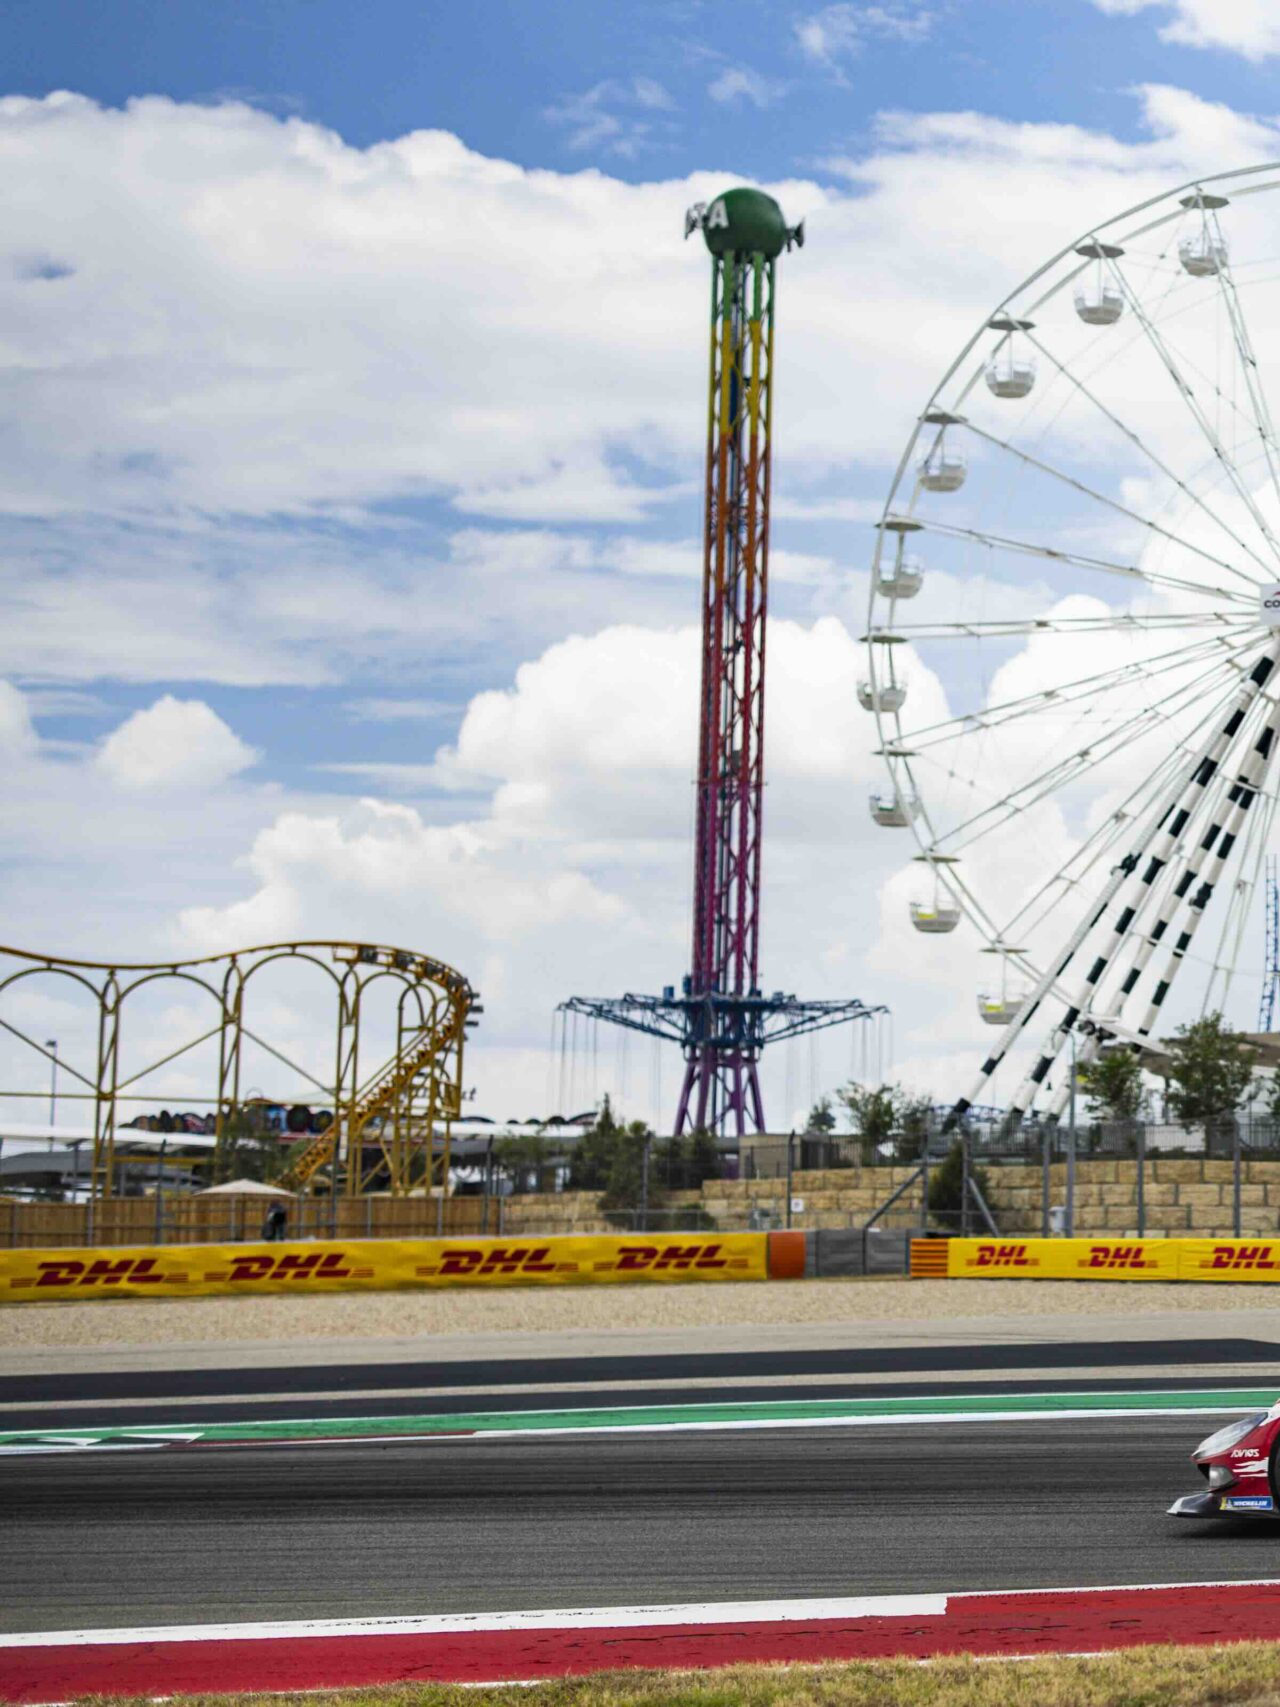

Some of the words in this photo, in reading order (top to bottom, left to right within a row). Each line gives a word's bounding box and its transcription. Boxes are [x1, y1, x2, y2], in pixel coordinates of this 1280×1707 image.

[228, 1253, 350, 1281] DHL
[438, 1248, 556, 1276] DHL
[616, 1245, 729, 1270] DHL
[976, 1246, 1029, 1266] DHL
[1089, 1247, 1146, 1268] DHL
[1213, 1247, 1275, 1269] DHL
[36, 1258, 165, 1286] DHL
